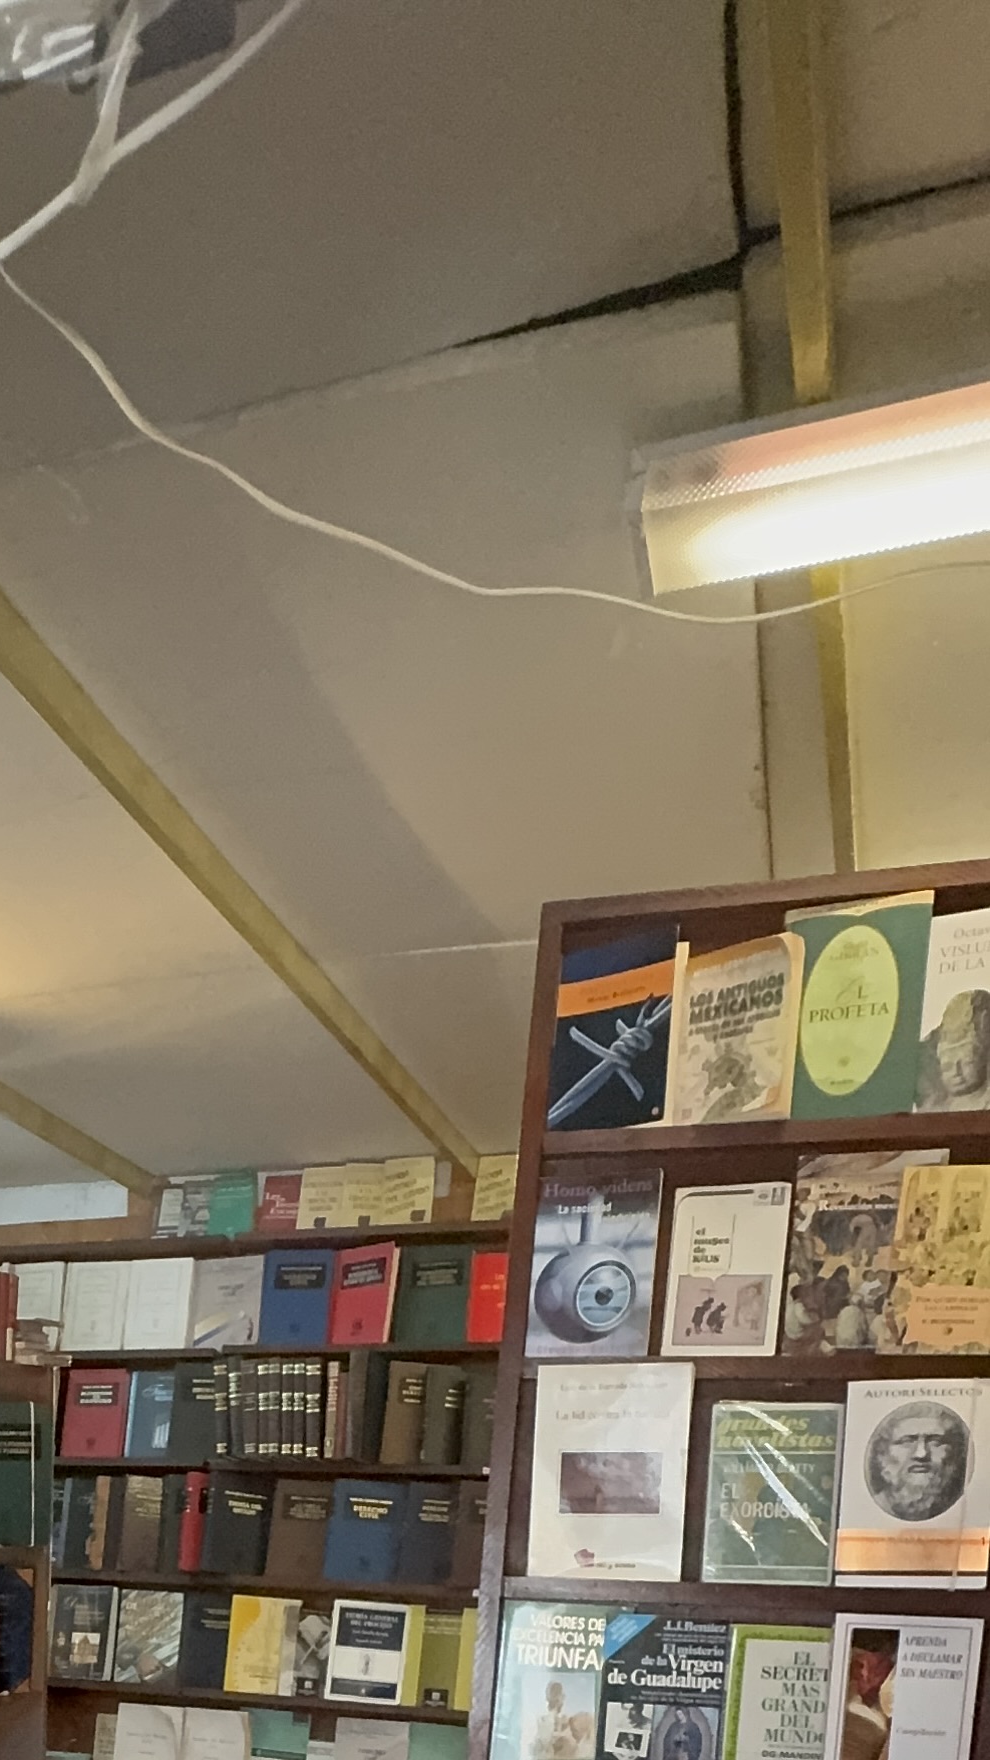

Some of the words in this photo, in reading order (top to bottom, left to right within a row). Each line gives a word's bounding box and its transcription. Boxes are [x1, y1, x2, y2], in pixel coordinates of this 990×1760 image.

[940, 941, 990, 958] VISLU
[965, 957, 985, 971] LA
[717, 972, 785, 1001] ANTIGUOS
[689, 987, 784, 1025] MEXICANOS
[809, 1002, 889, 1023] PROFETA
[544, 1181, 597, 1198] Homo
[601, 1178, 654, 1194] videns
[721, 1482, 740, 1499] EL
[720, 1502, 811, 1519] EXORCISA
[531, 1614, 586, 1631] VALORES
[588, 1617, 606, 1632] DE
[677, 1644, 724, 1657] misterio
[793, 1651, 816, 1666] EL
[641, 1655, 656, 1666] de
[656, 1655, 668, 1667] la
[668, 1653, 724, 1675] Virgen
[607, 1668, 628, 1686] de
[630, 1668, 723, 1692] Guadalupe
[760, 1666, 829, 1683] SECRET
[781, 1683, 821, 1698] MAS
[761, 1697, 826, 1715] GRAND
[779, 1714, 814, 1728] DEL
